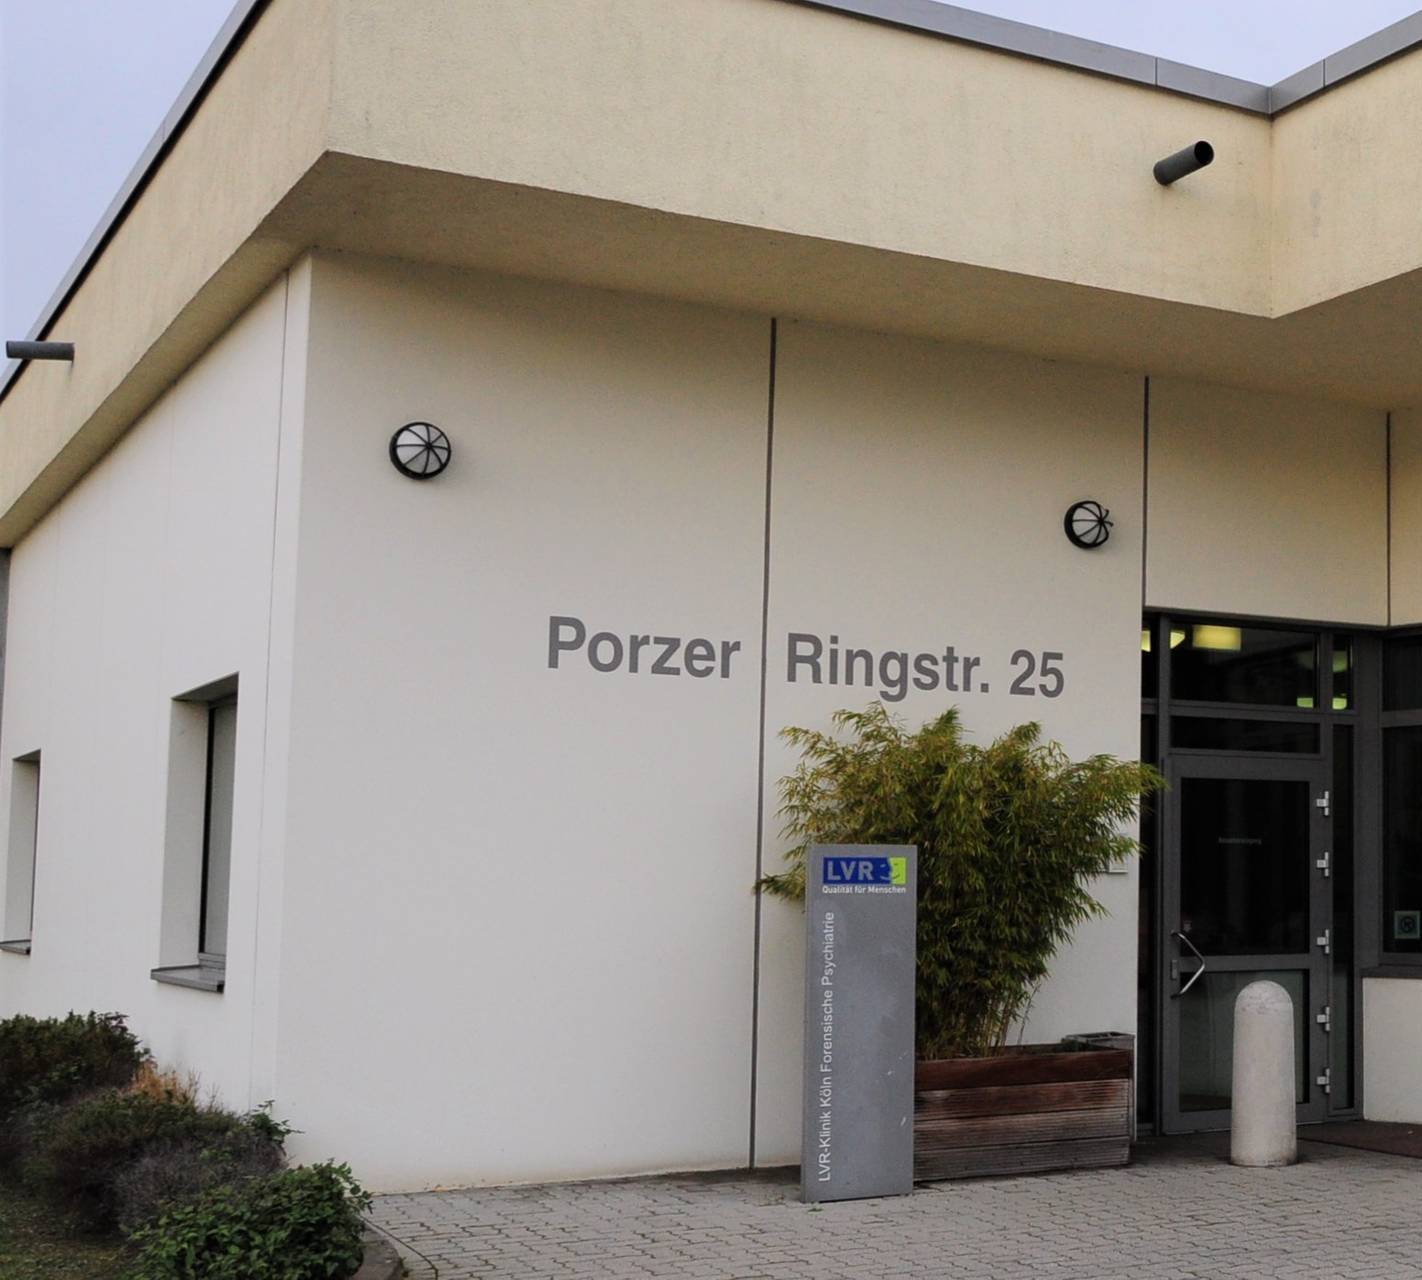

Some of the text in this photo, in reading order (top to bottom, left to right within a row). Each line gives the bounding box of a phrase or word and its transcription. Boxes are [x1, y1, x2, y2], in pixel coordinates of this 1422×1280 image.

[548, 615, 1065, 702] Porzer Ringstr. 25
[822, 885, 907, 894] Qualität für Menschen
[827, 860, 875, 881] LVR
[818, 912, 837, 1181] LVR-Klinik Köln Forensische Psychiatrie
